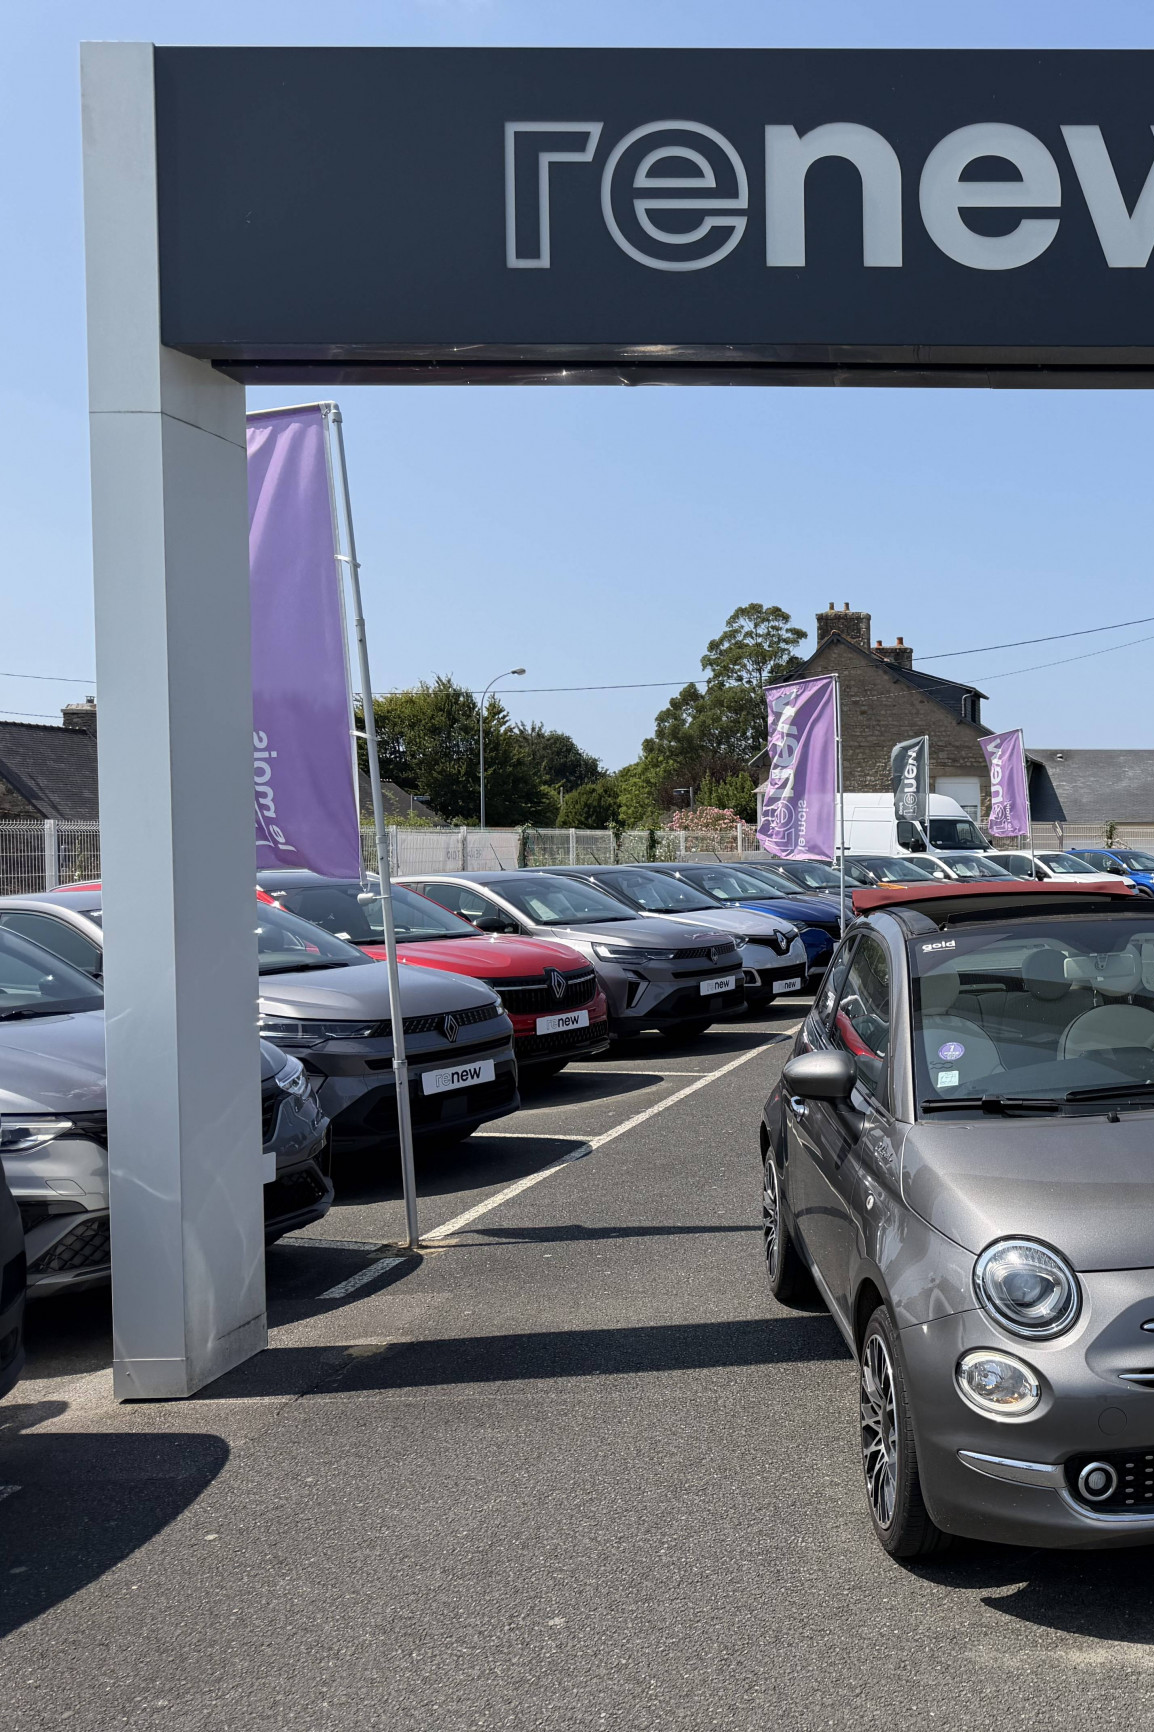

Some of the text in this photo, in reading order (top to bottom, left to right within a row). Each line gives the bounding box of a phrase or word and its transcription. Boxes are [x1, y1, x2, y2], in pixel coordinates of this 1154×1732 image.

[922, 940, 956, 952] gold
[546, 1015, 580, 1031] renew
[435, 1066, 481, 1088] renew
